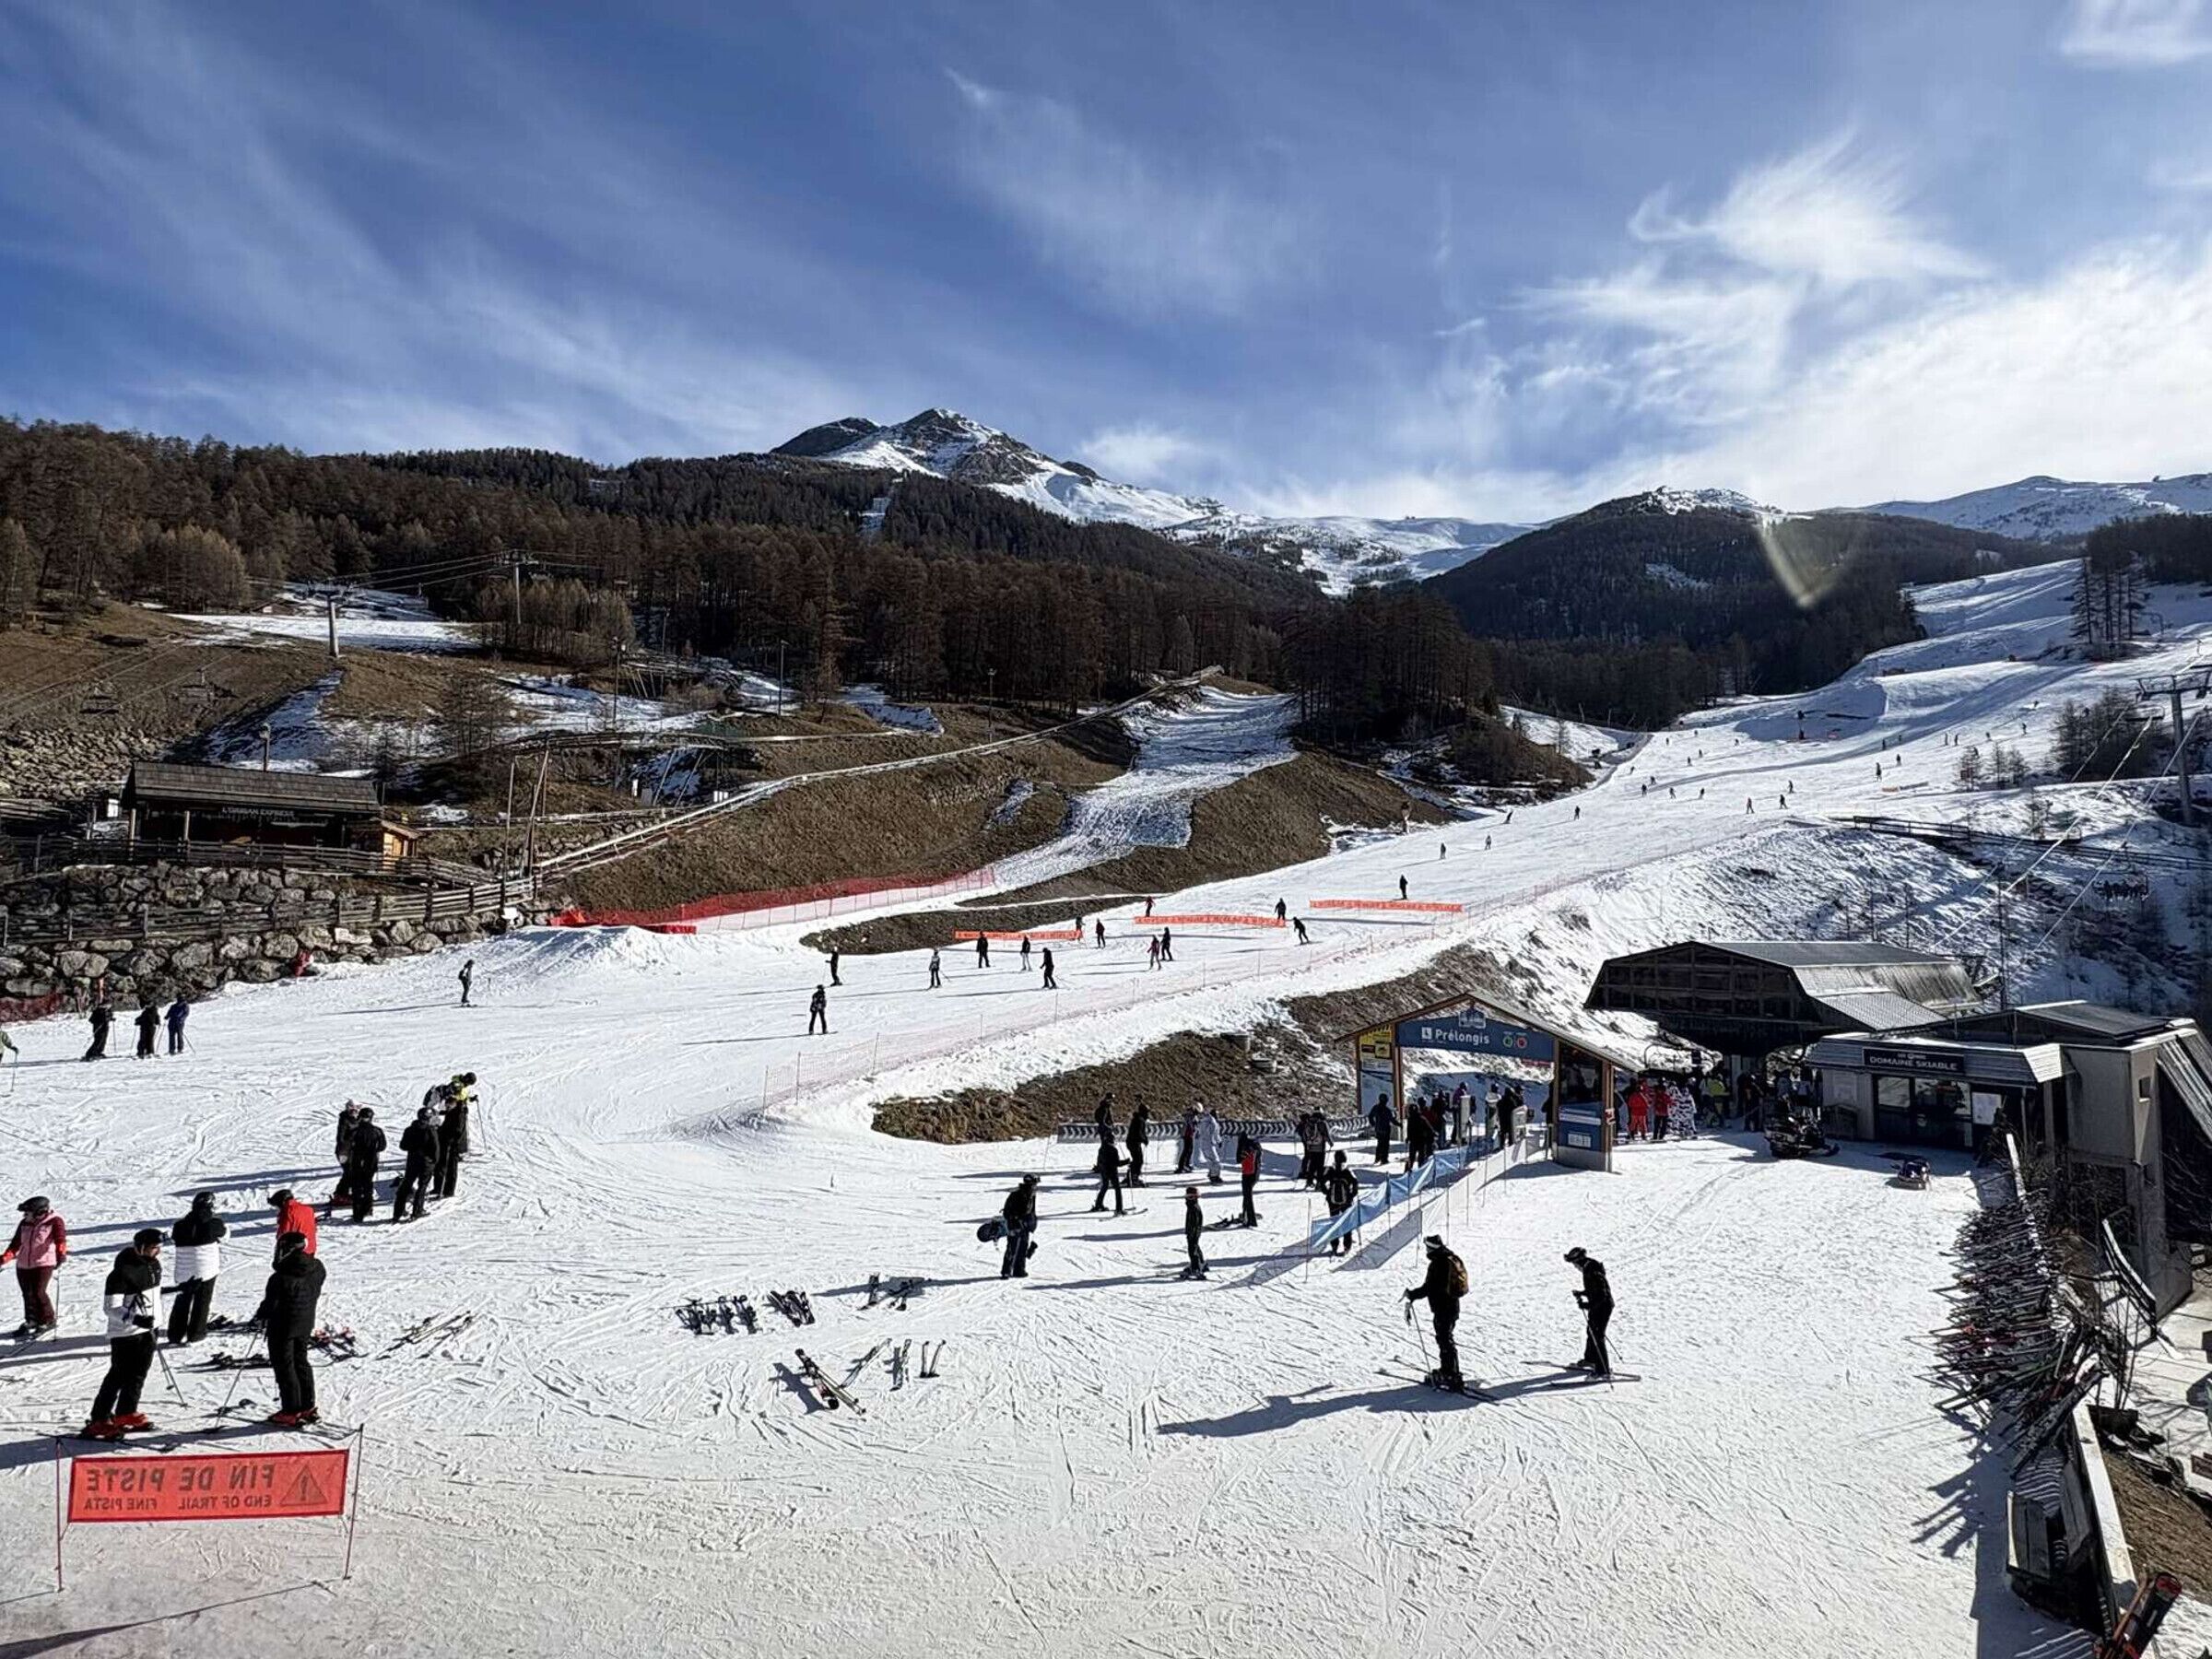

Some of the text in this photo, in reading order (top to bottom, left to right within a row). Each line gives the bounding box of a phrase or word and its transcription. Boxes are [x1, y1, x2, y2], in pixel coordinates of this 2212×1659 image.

[1435, 1028, 1490, 1046] Prélongis
[1869, 1056, 1913, 1067] DOMAINE
[1916, 1060, 1958, 1070] SKIABLE
